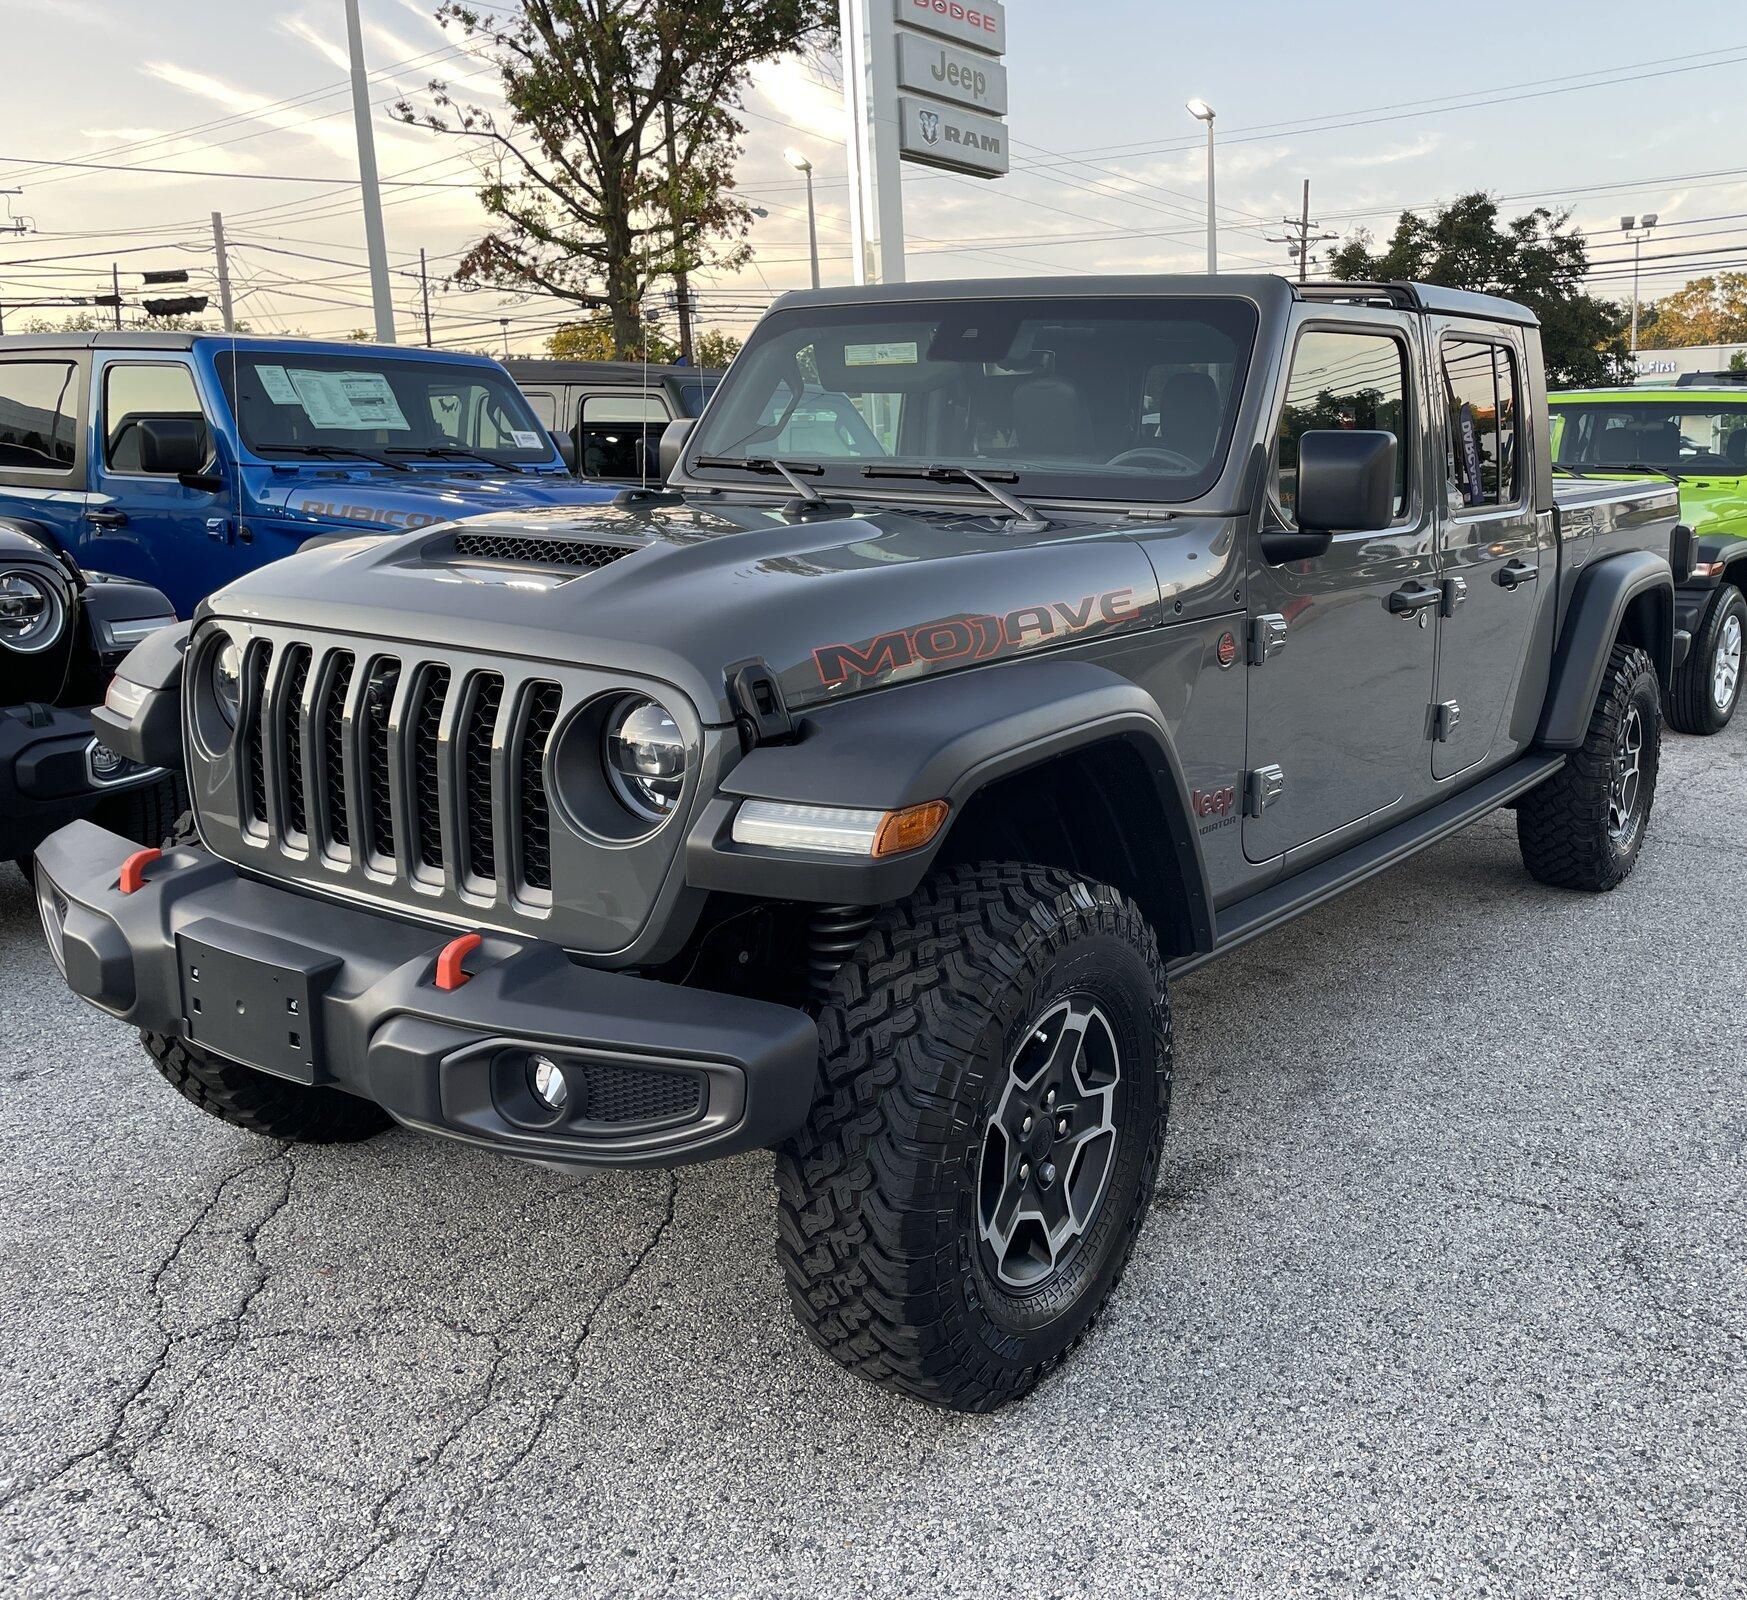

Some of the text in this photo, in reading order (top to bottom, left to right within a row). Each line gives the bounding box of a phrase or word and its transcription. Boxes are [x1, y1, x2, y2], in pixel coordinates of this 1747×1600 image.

[931, 51, 987, 99] Jeep
[944, 125, 1000, 153] RAM
[1648, 361, 1676, 373] First
[812, 587, 1140, 684] MOJAVE
